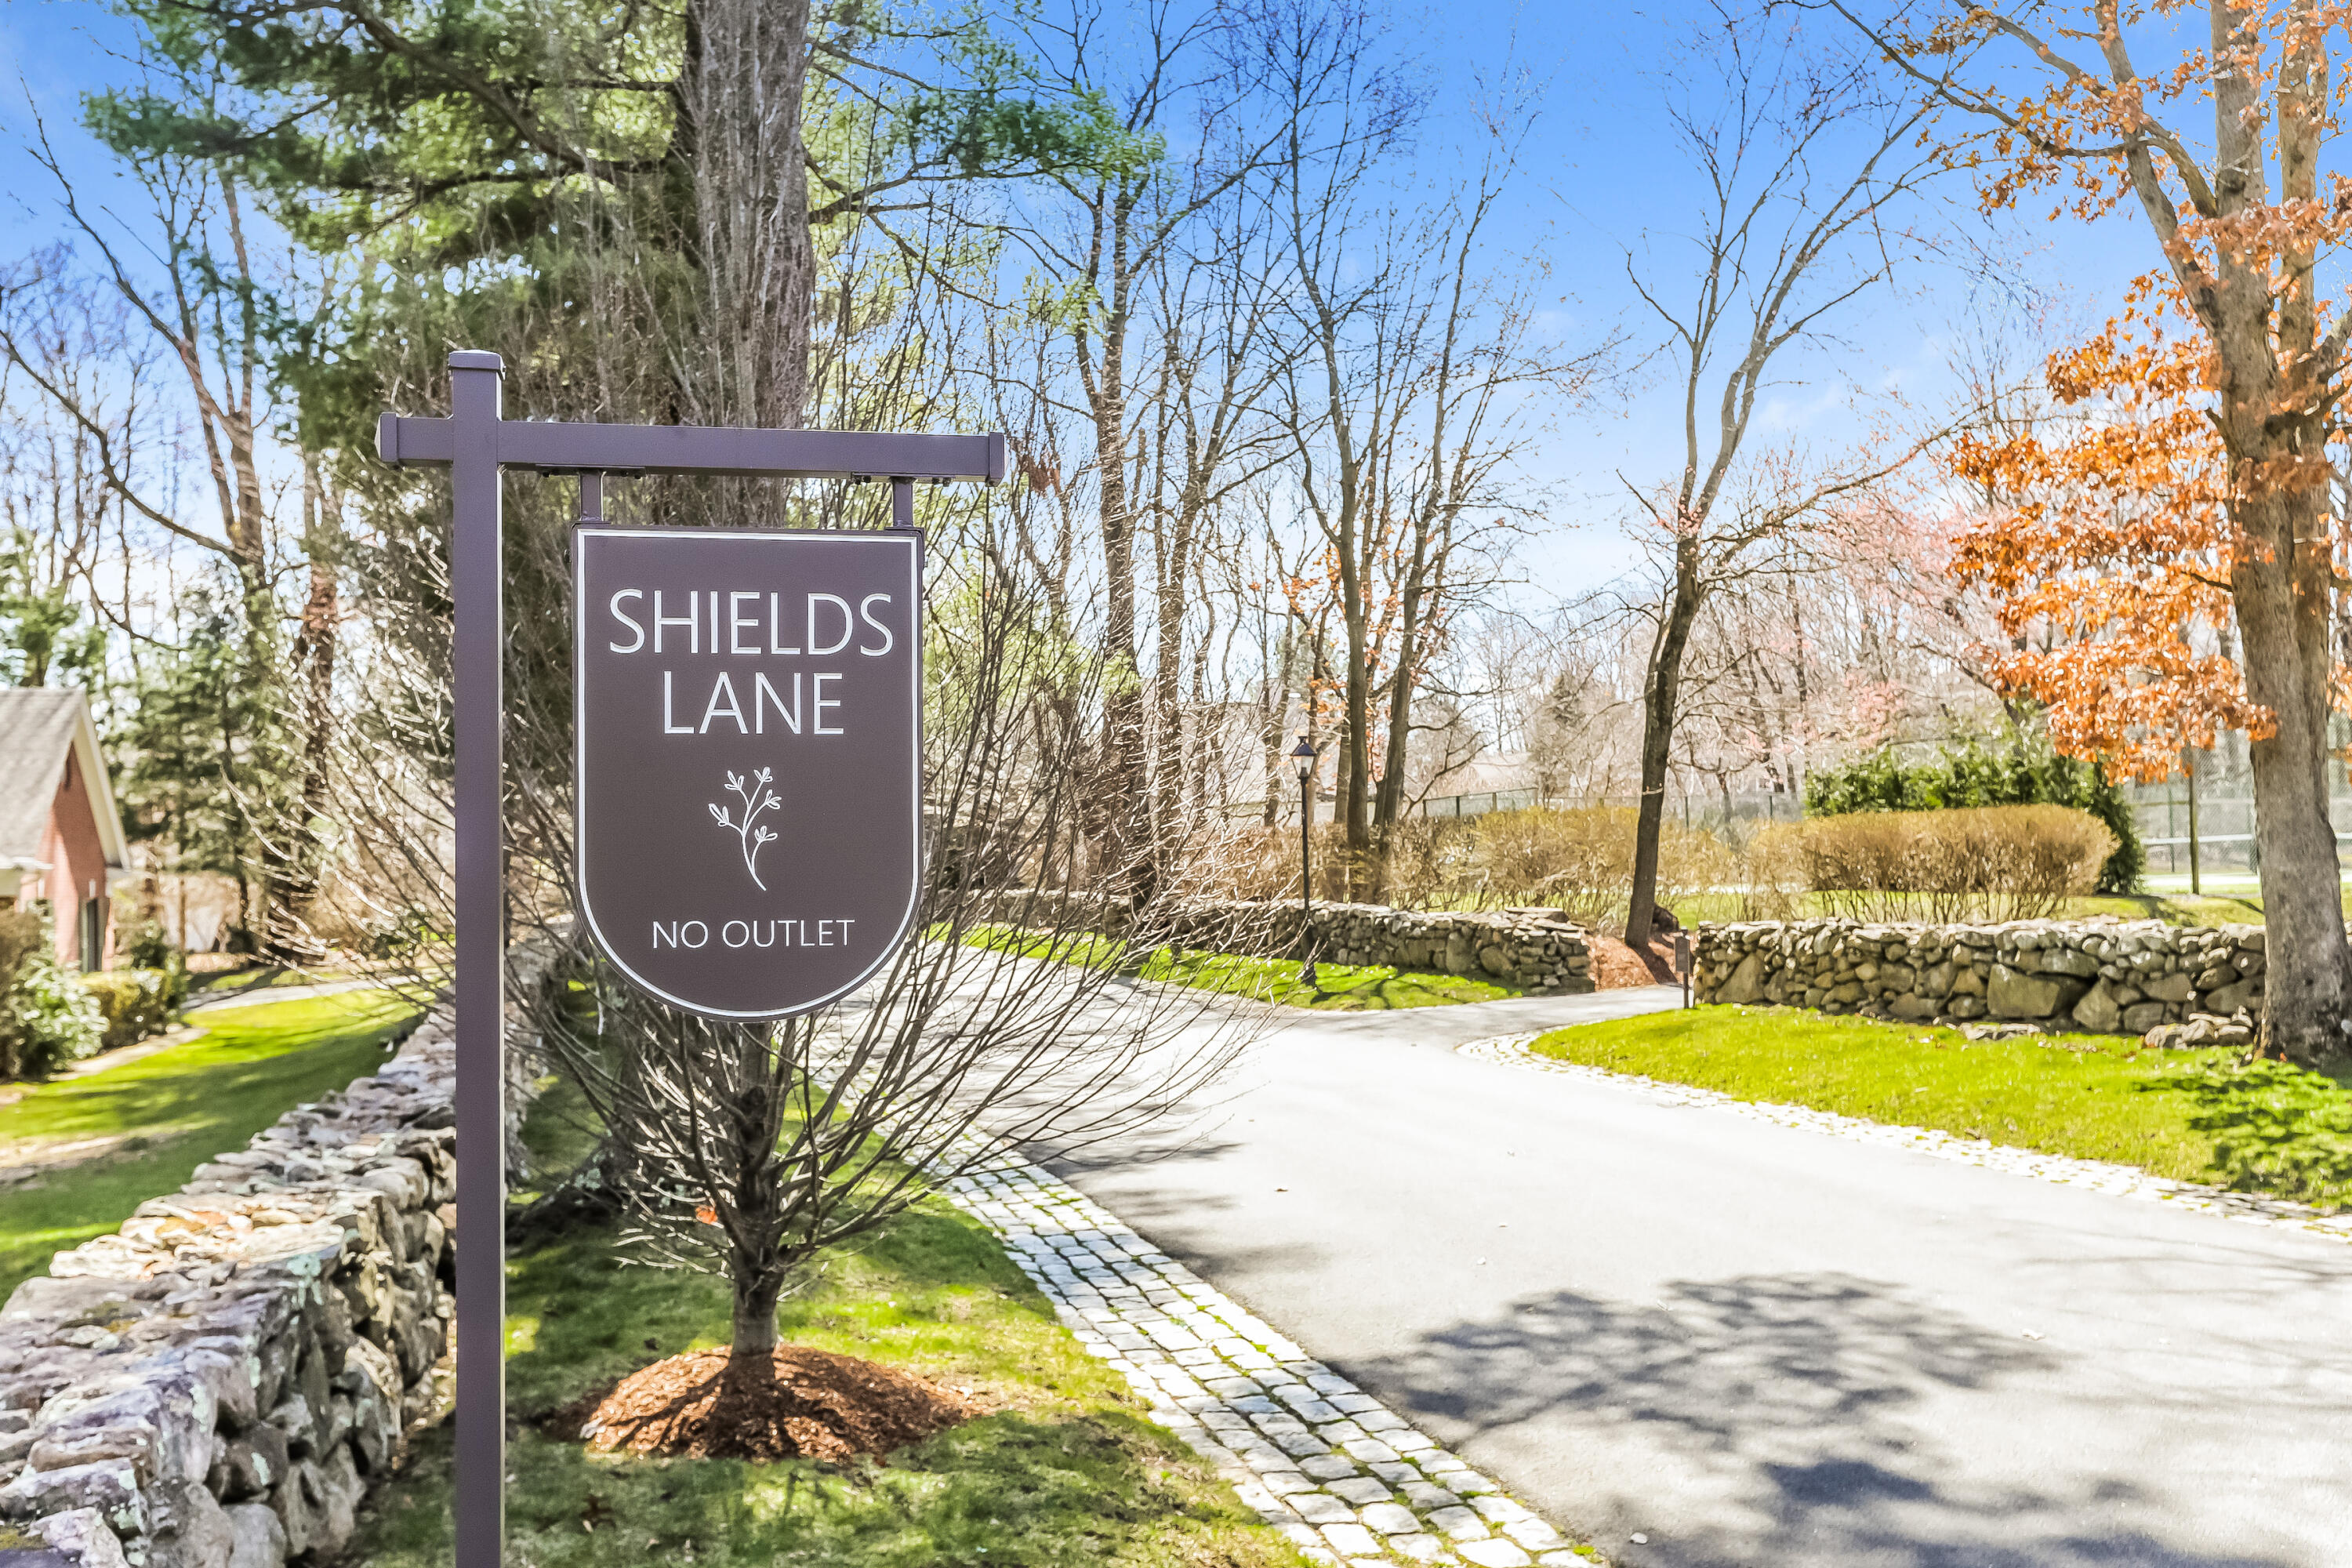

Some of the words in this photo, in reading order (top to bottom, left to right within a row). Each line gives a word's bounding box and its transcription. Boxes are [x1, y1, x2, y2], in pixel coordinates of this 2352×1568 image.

[609, 588, 894, 657] SHIELDS
[663, 670, 844, 735] LANE
[652, 920, 708, 949] NO
[722, 919, 855, 948] OUTLET
